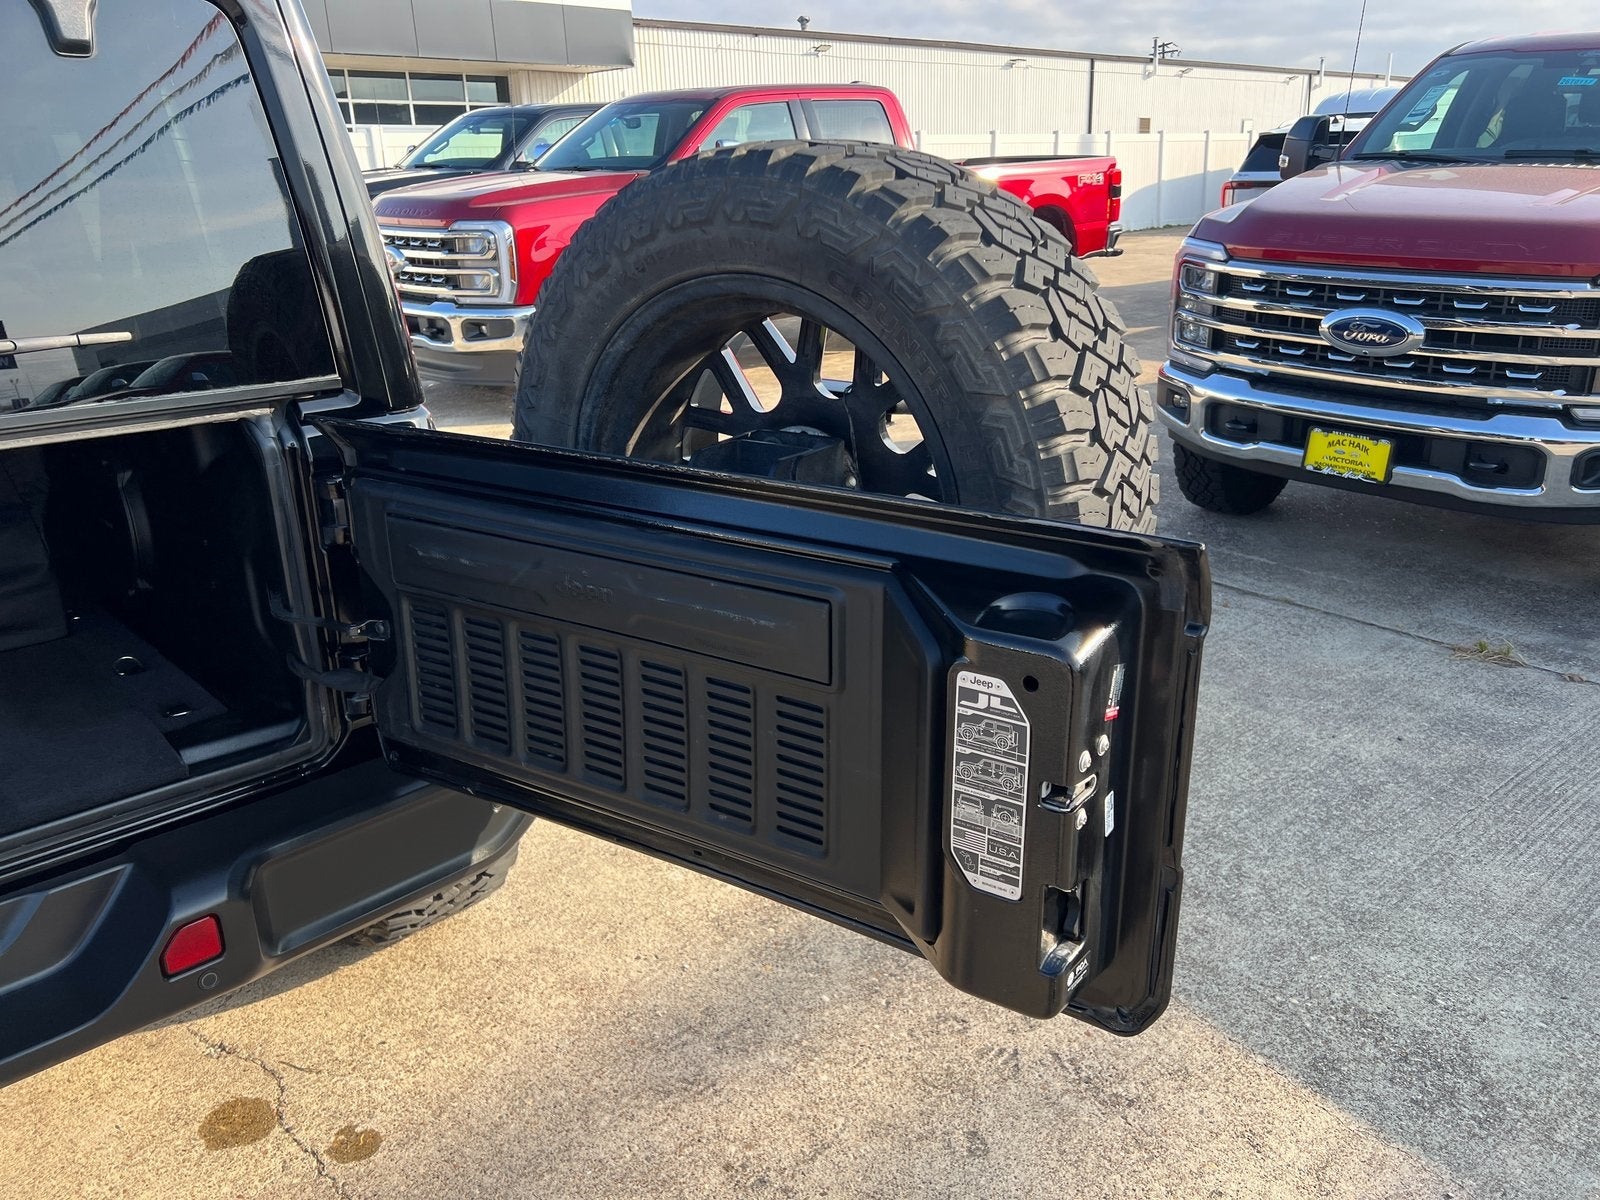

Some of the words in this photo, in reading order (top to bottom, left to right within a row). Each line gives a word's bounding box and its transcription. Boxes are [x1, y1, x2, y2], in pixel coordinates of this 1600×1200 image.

[1078, 172, 1104, 187] FX4
[1343, 321, 1392, 343] Ford
[1326, 438, 1347, 449] MAC
[1348, 439, 1370, 455] HAIK
[1328, 455, 1363, 467] VICTORIA
[969, 676, 994, 689] Jeep
[960, 692, 1018, 713] JL
[988, 845, 1020, 861] U.S.A.
